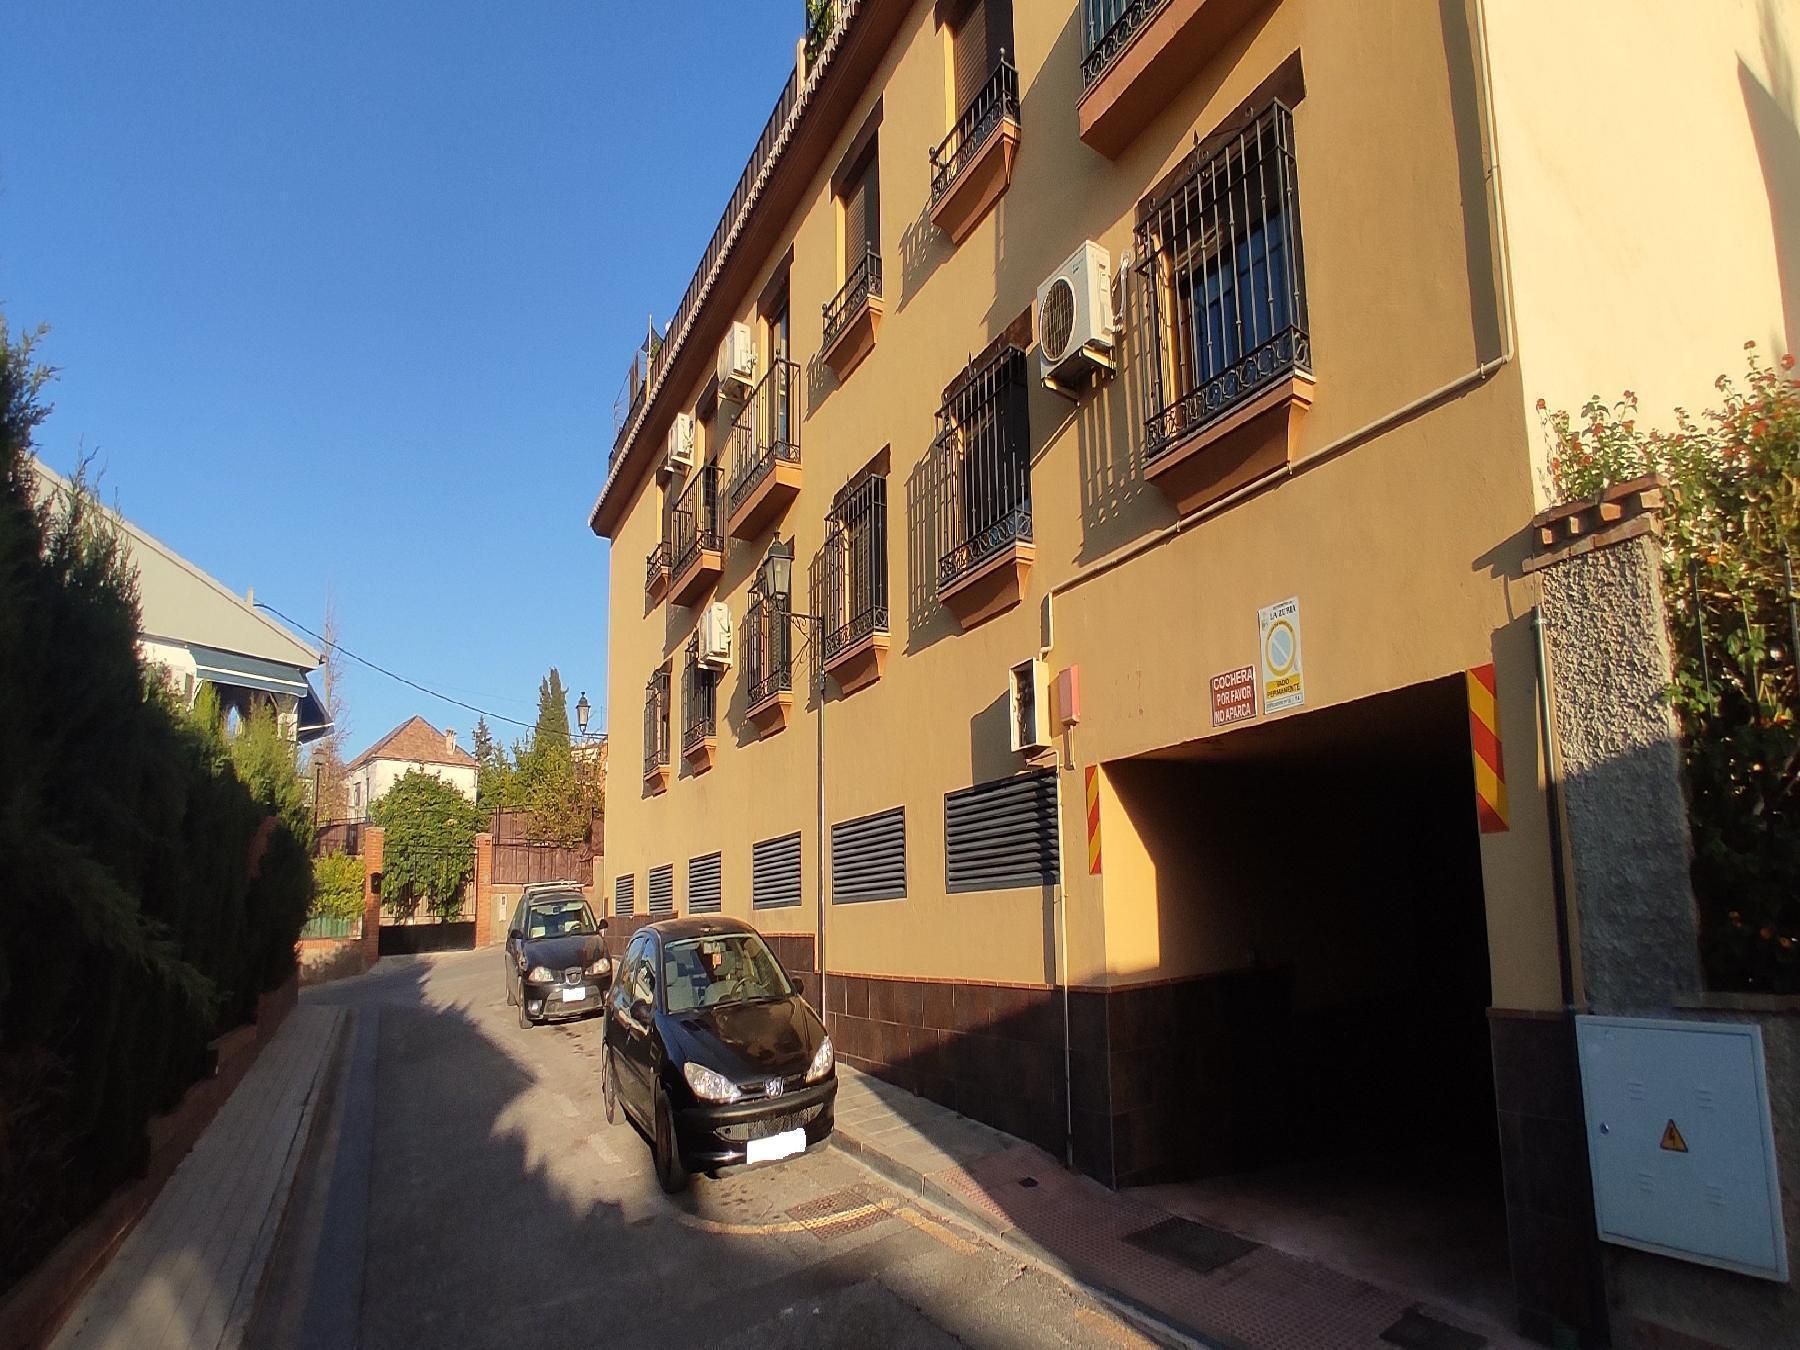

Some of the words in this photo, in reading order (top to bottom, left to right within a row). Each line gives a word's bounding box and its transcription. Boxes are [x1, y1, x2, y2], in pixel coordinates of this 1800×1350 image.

[1214, 669, 1252, 690] COCHERA
[1217, 691, 1230, 706] POR
[1231, 686, 1251, 703] FAVOR
[1215, 710, 1224, 724] NO
[1226, 703, 1251, 720] APARCA
